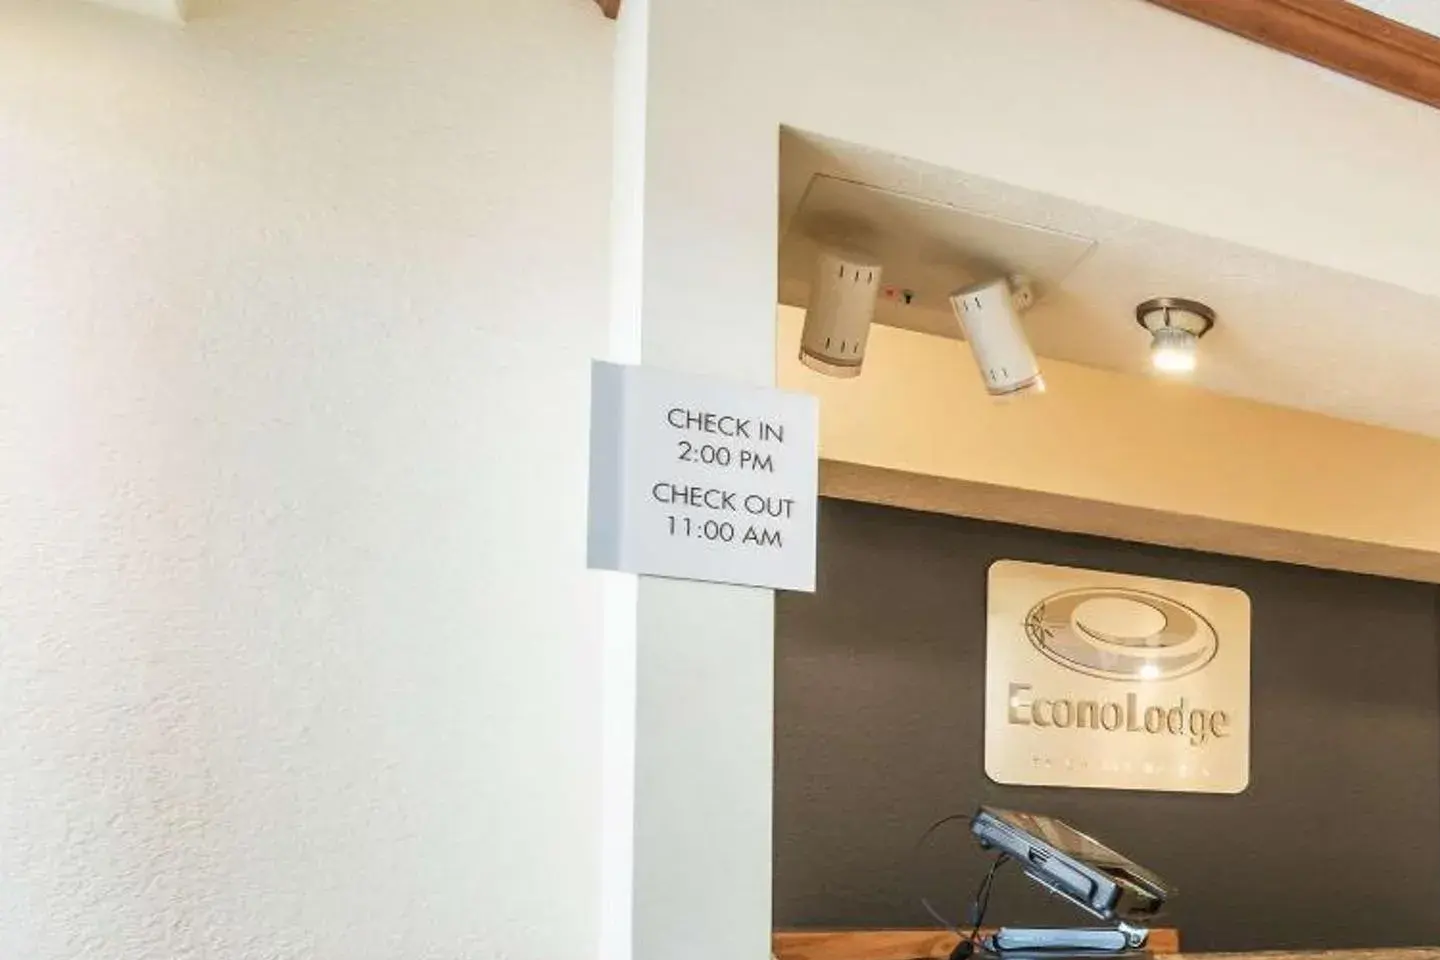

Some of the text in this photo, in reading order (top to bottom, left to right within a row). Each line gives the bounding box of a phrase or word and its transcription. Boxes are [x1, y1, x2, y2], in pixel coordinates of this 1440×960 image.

[667, 408, 784, 443] CHECK IN
[678, 441, 774, 472] 2:00 PM
[652, 483, 795, 518] CHECK OUT
[668, 515, 782, 548] 11:00 AM
